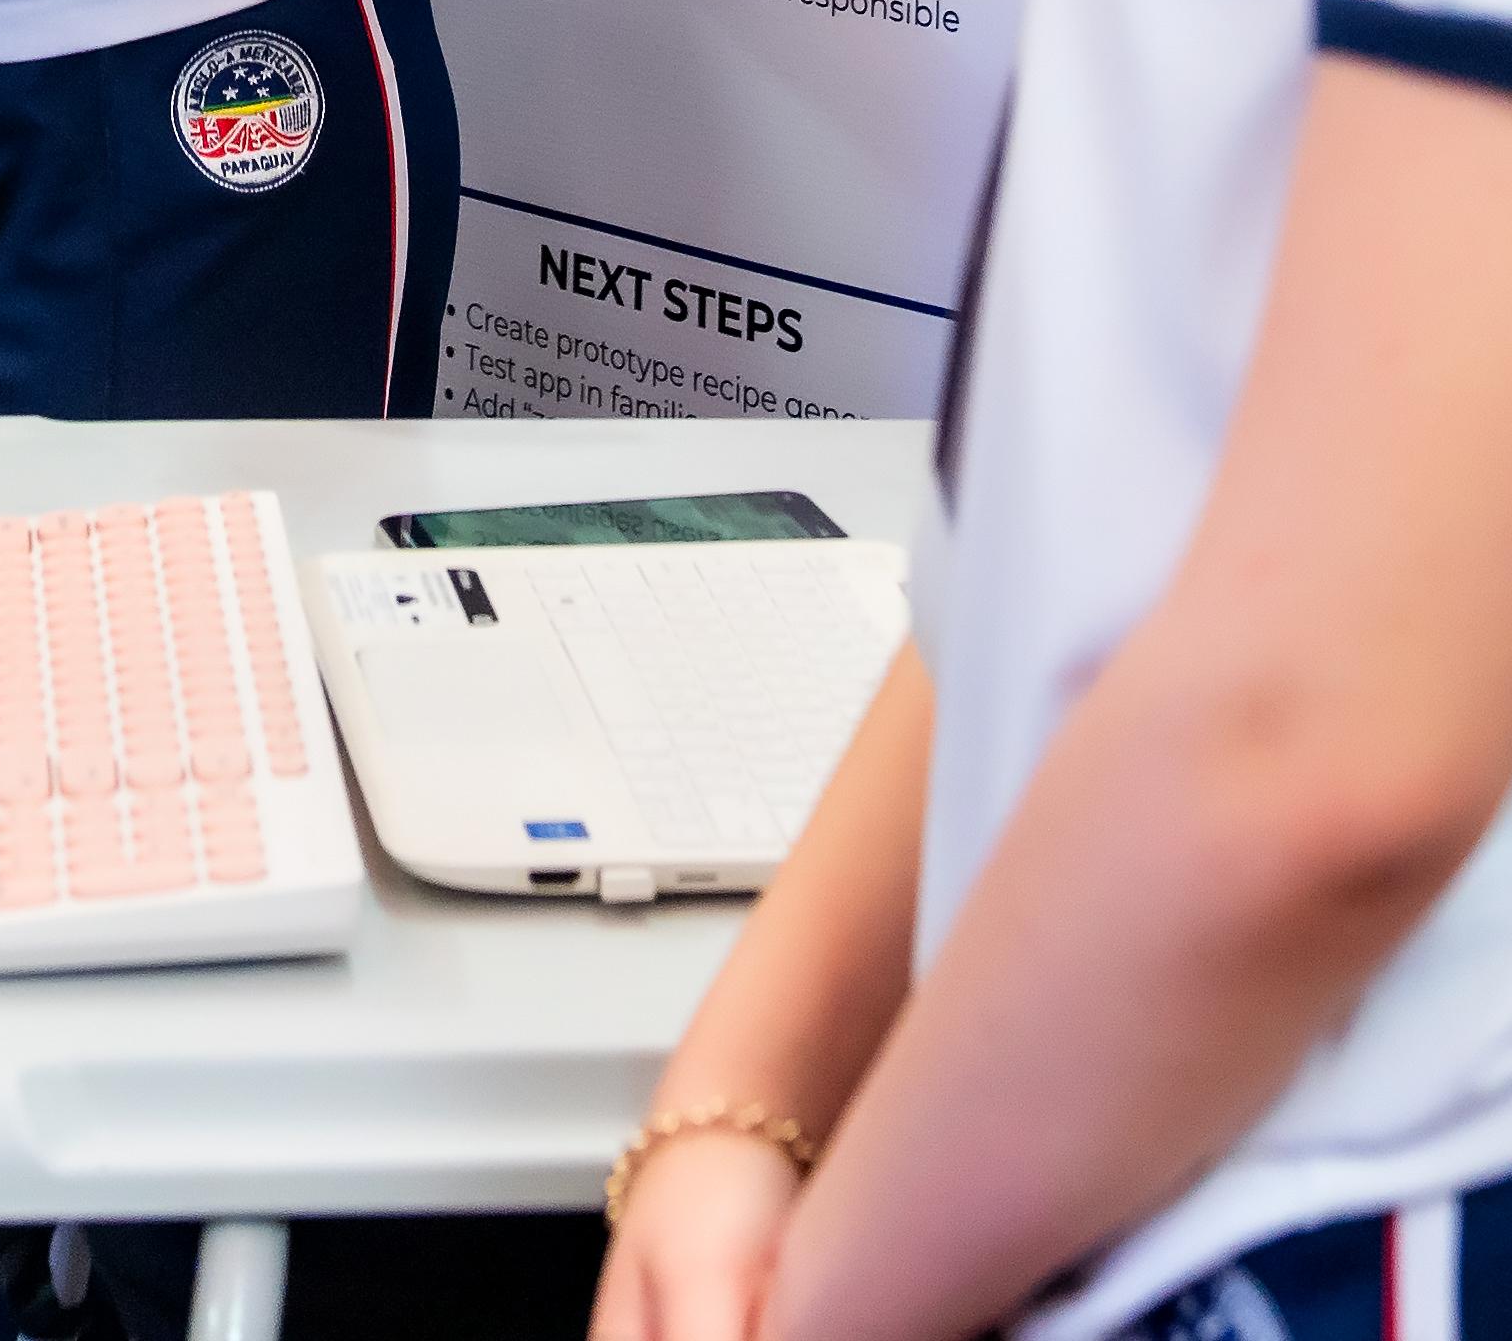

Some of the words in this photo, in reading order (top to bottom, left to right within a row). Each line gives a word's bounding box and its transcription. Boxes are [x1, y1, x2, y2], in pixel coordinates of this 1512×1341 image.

[220, 151, 295, 178] PARAGUAY
[538, 243, 653, 312] NEXT
[662, 277, 804, 354] STEPS
[464, 343, 518, 384] Test
[523, 366, 573, 401] app
[578, 374, 603, 405] in
[465, 301, 551, 350] Create
[556, 327, 685, 388] prototype
[692, 368, 778, 415] recipe
